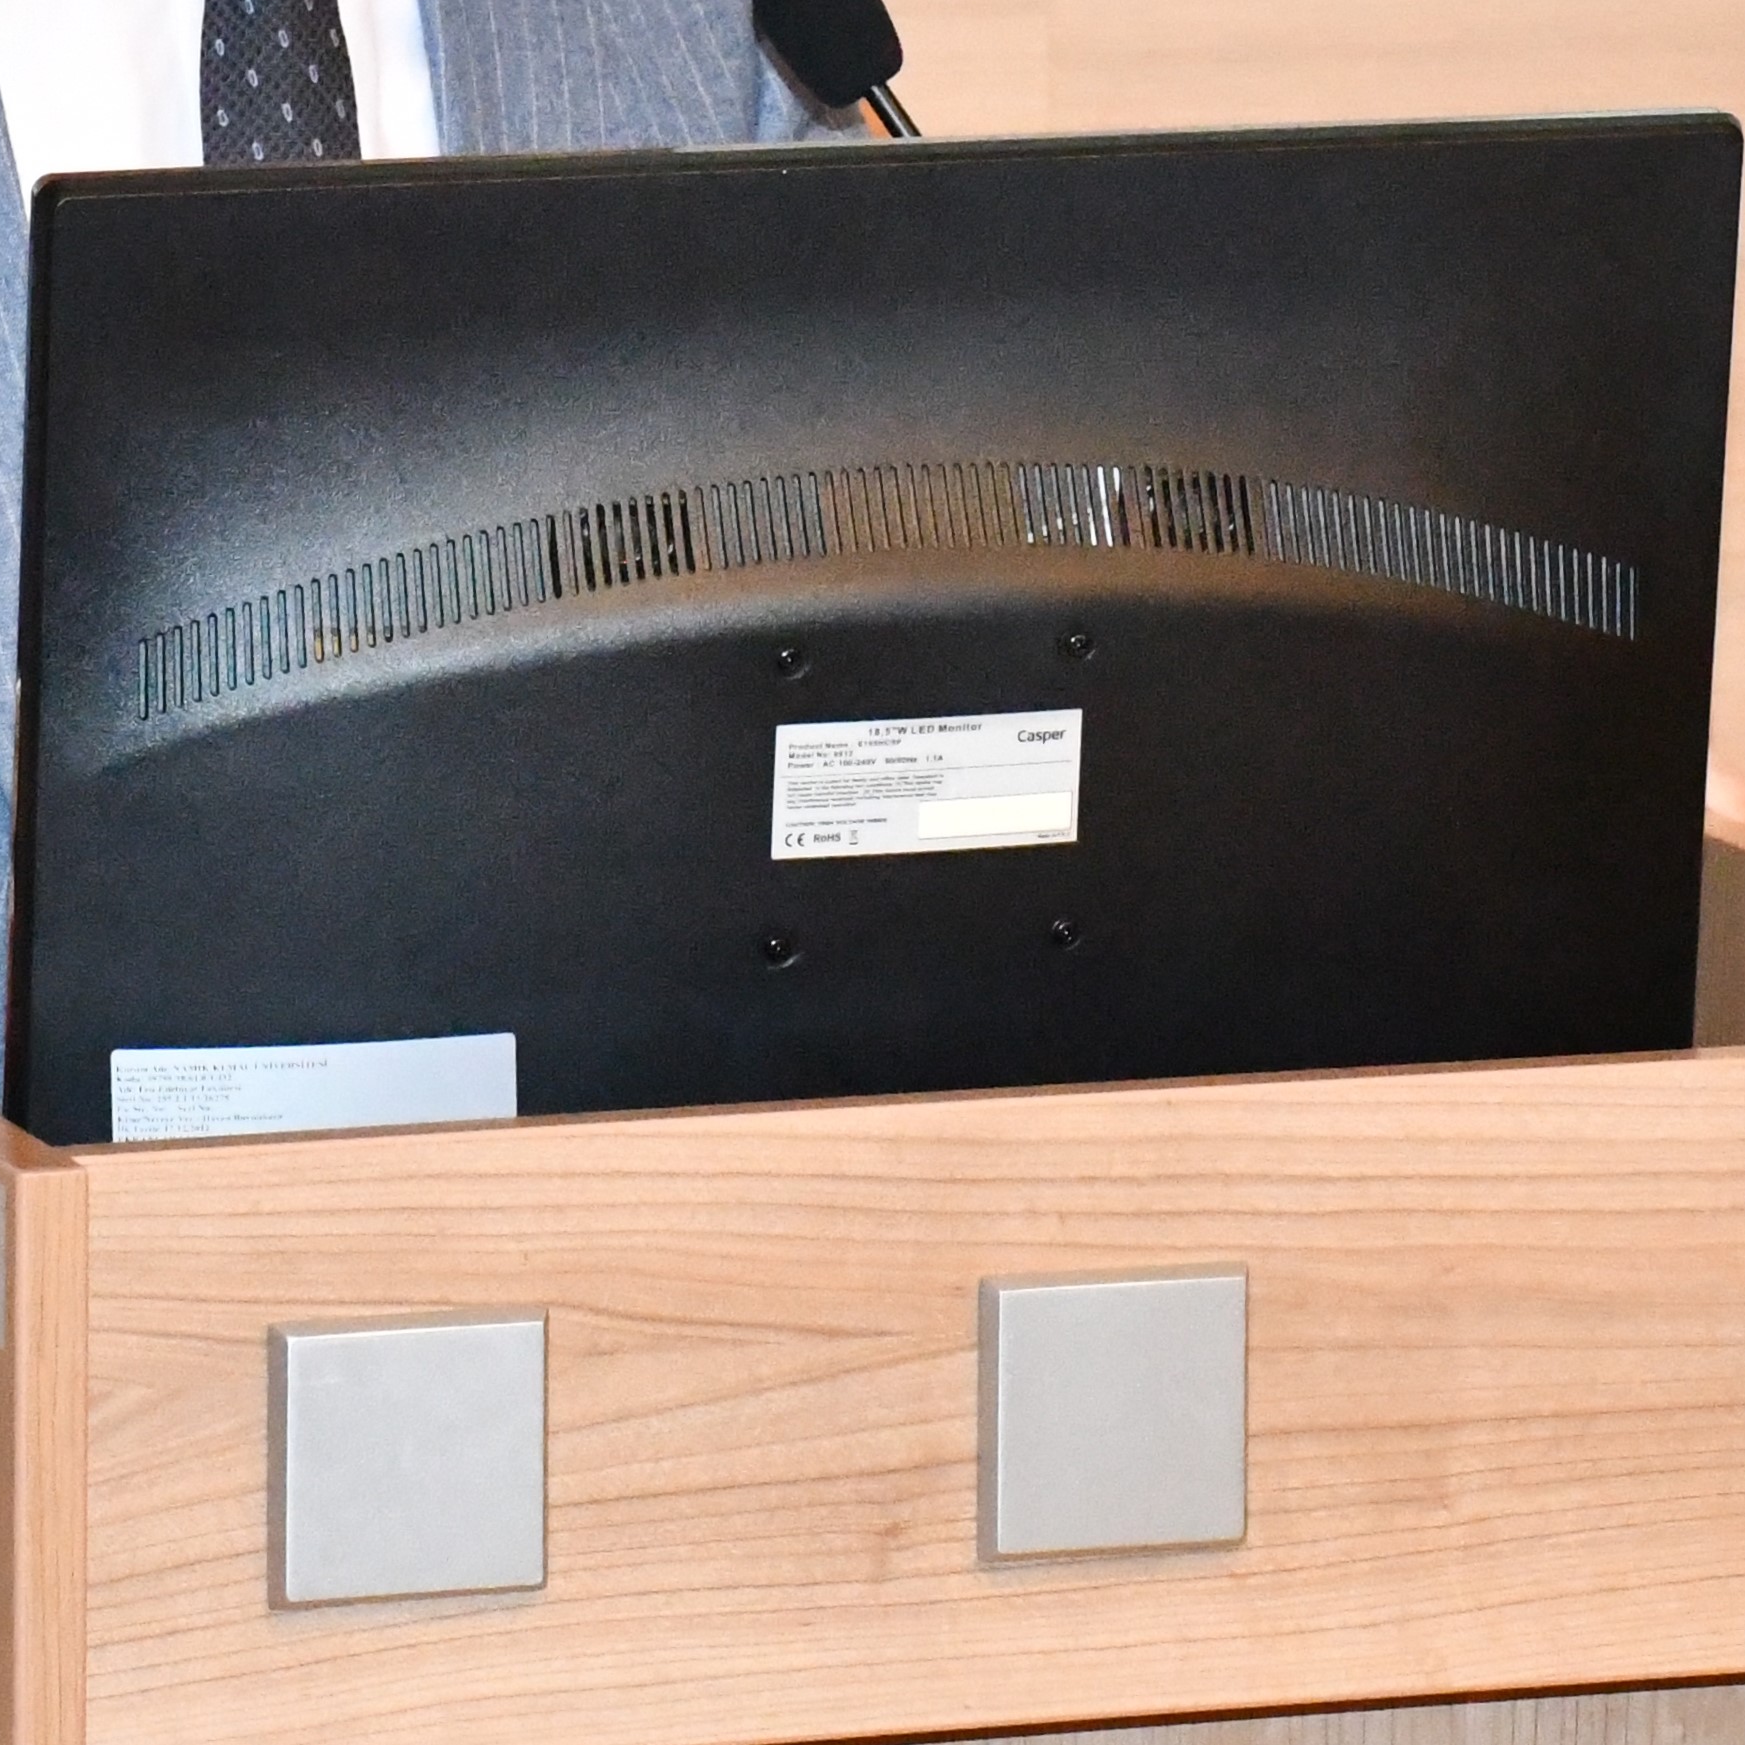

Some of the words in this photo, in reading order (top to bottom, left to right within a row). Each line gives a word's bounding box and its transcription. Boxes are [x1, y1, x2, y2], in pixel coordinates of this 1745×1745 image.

[911, 724, 935, 735] LED
[938, 722, 982, 733] Monitor
[1017, 728, 1067, 744] Casper
[822, 759, 836, 768] AC
[813, 831, 842, 843] RoHS
